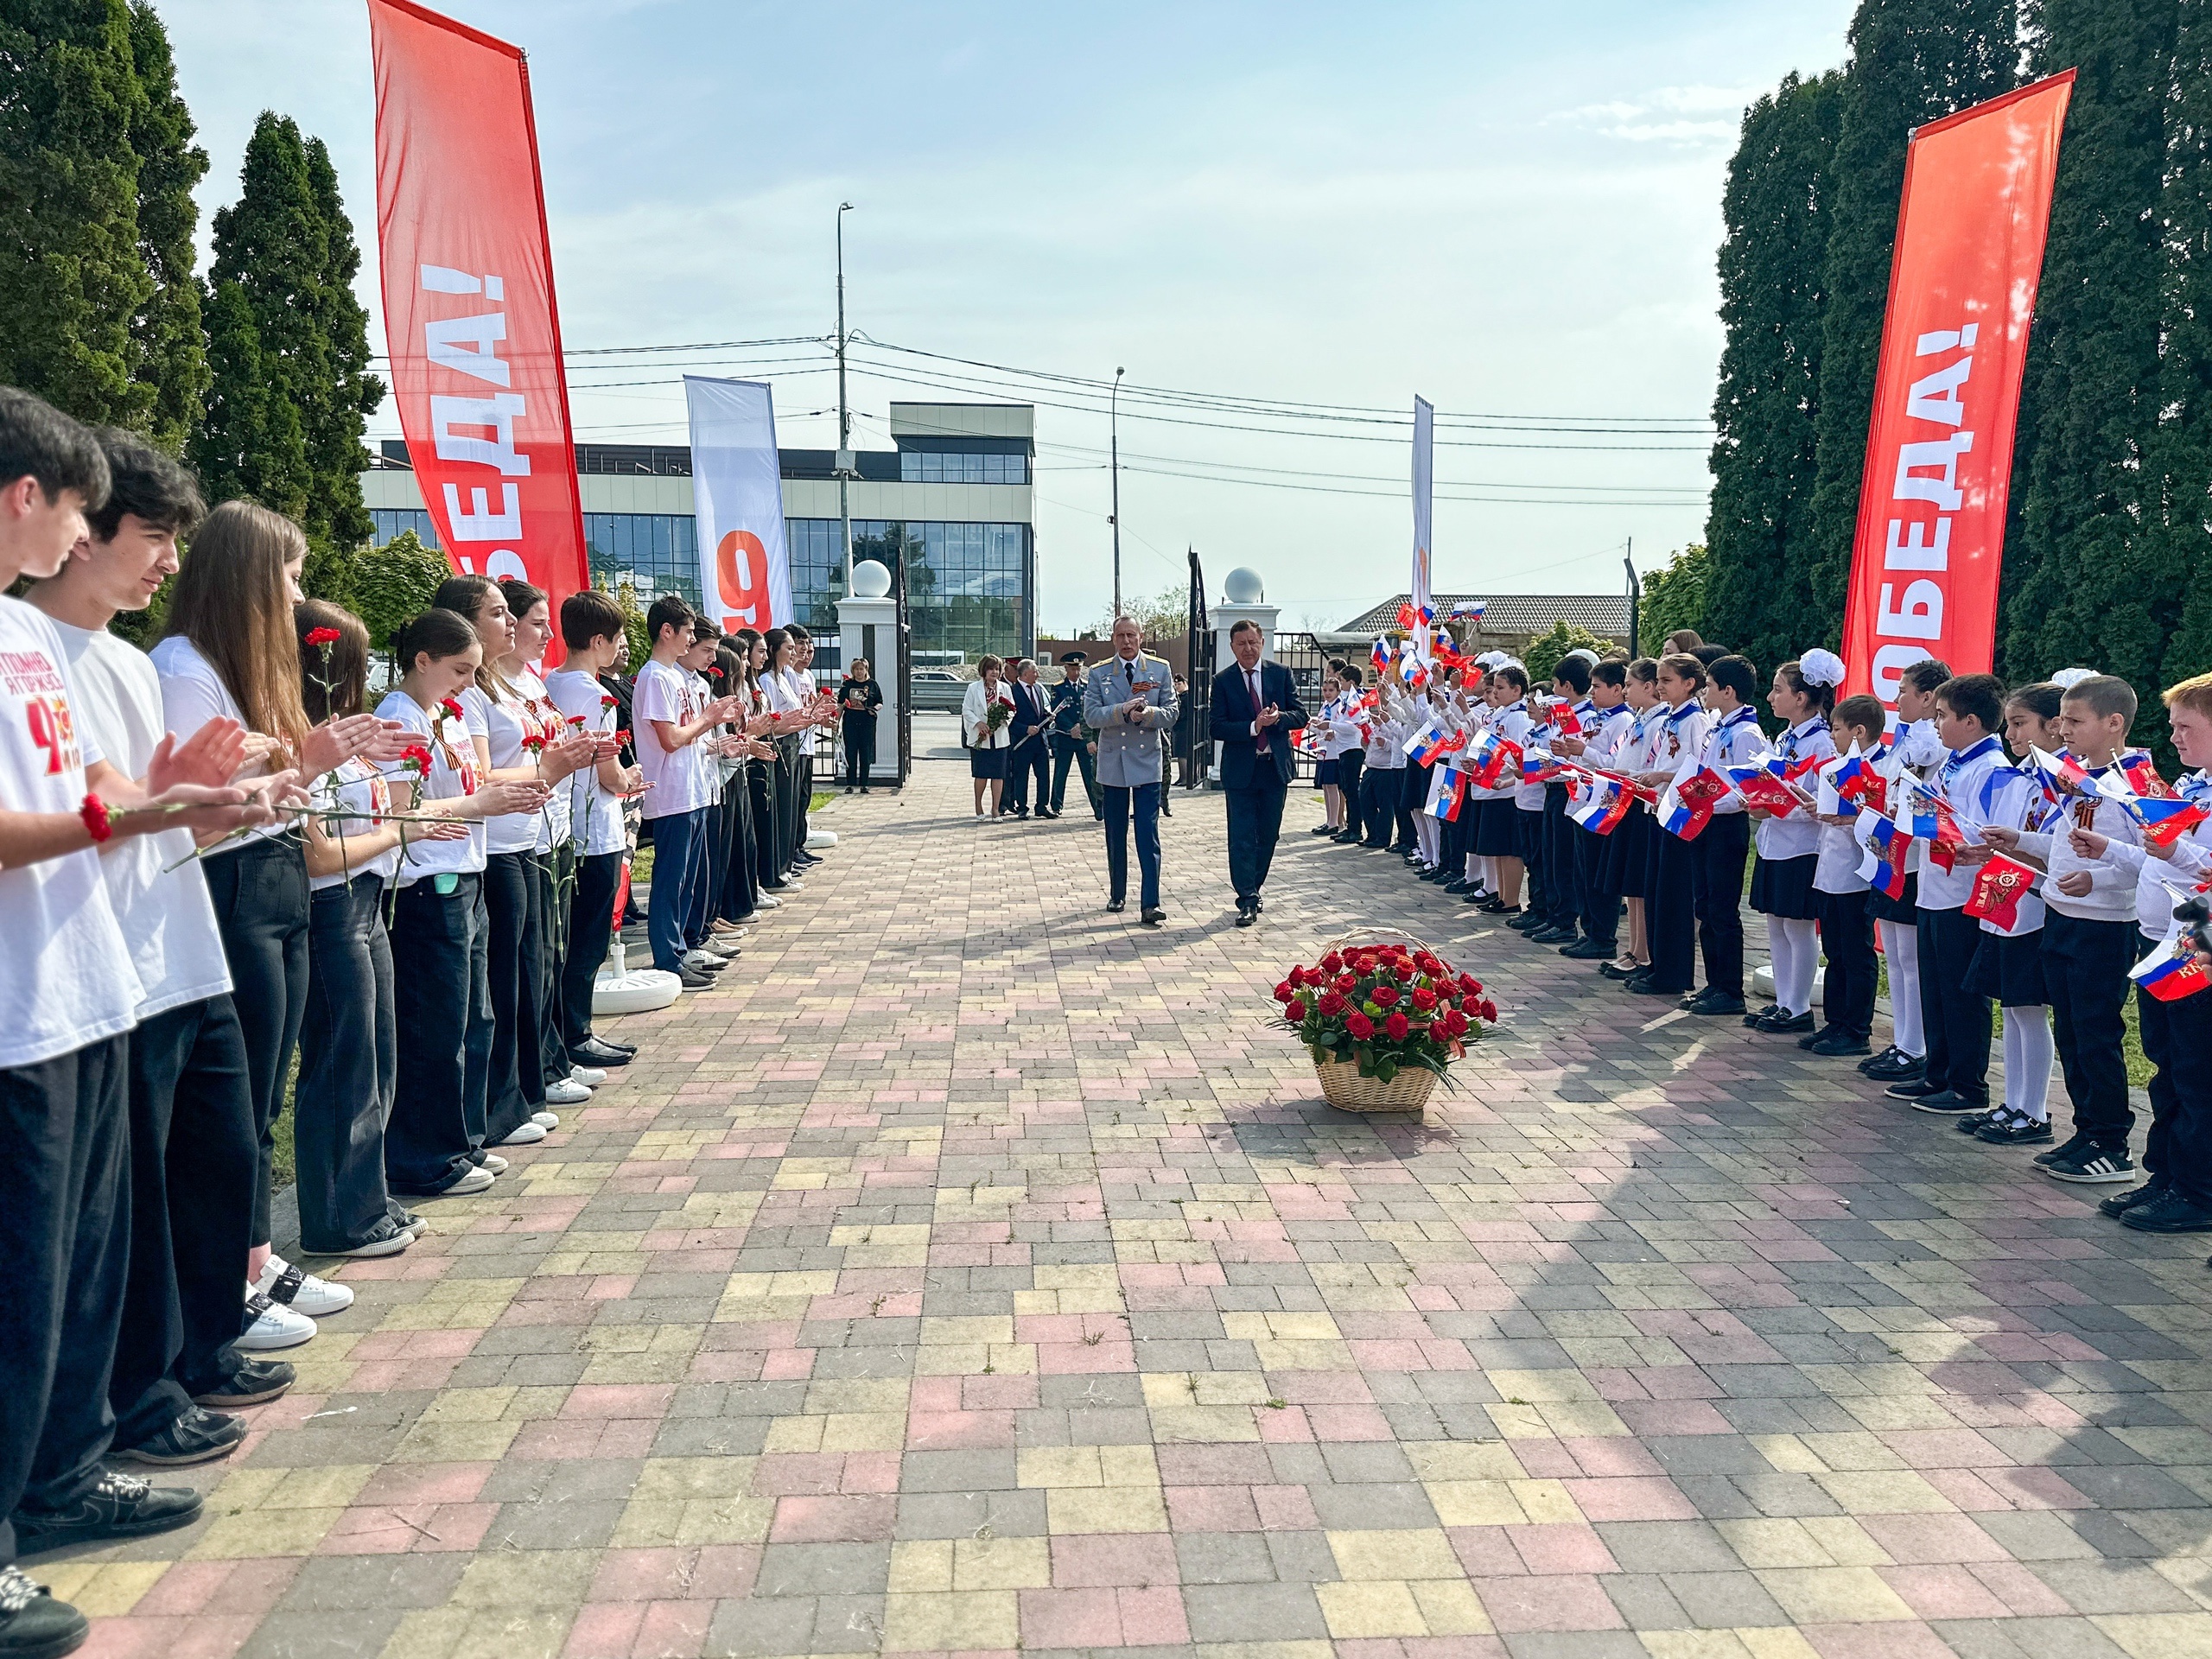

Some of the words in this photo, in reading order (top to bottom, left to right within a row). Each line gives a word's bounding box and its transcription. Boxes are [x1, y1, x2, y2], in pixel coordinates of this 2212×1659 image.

[716, 529, 772, 636] 9
[1871, 322, 1980, 749] ОБЕДА!
[25, 695, 64, 776] 9
